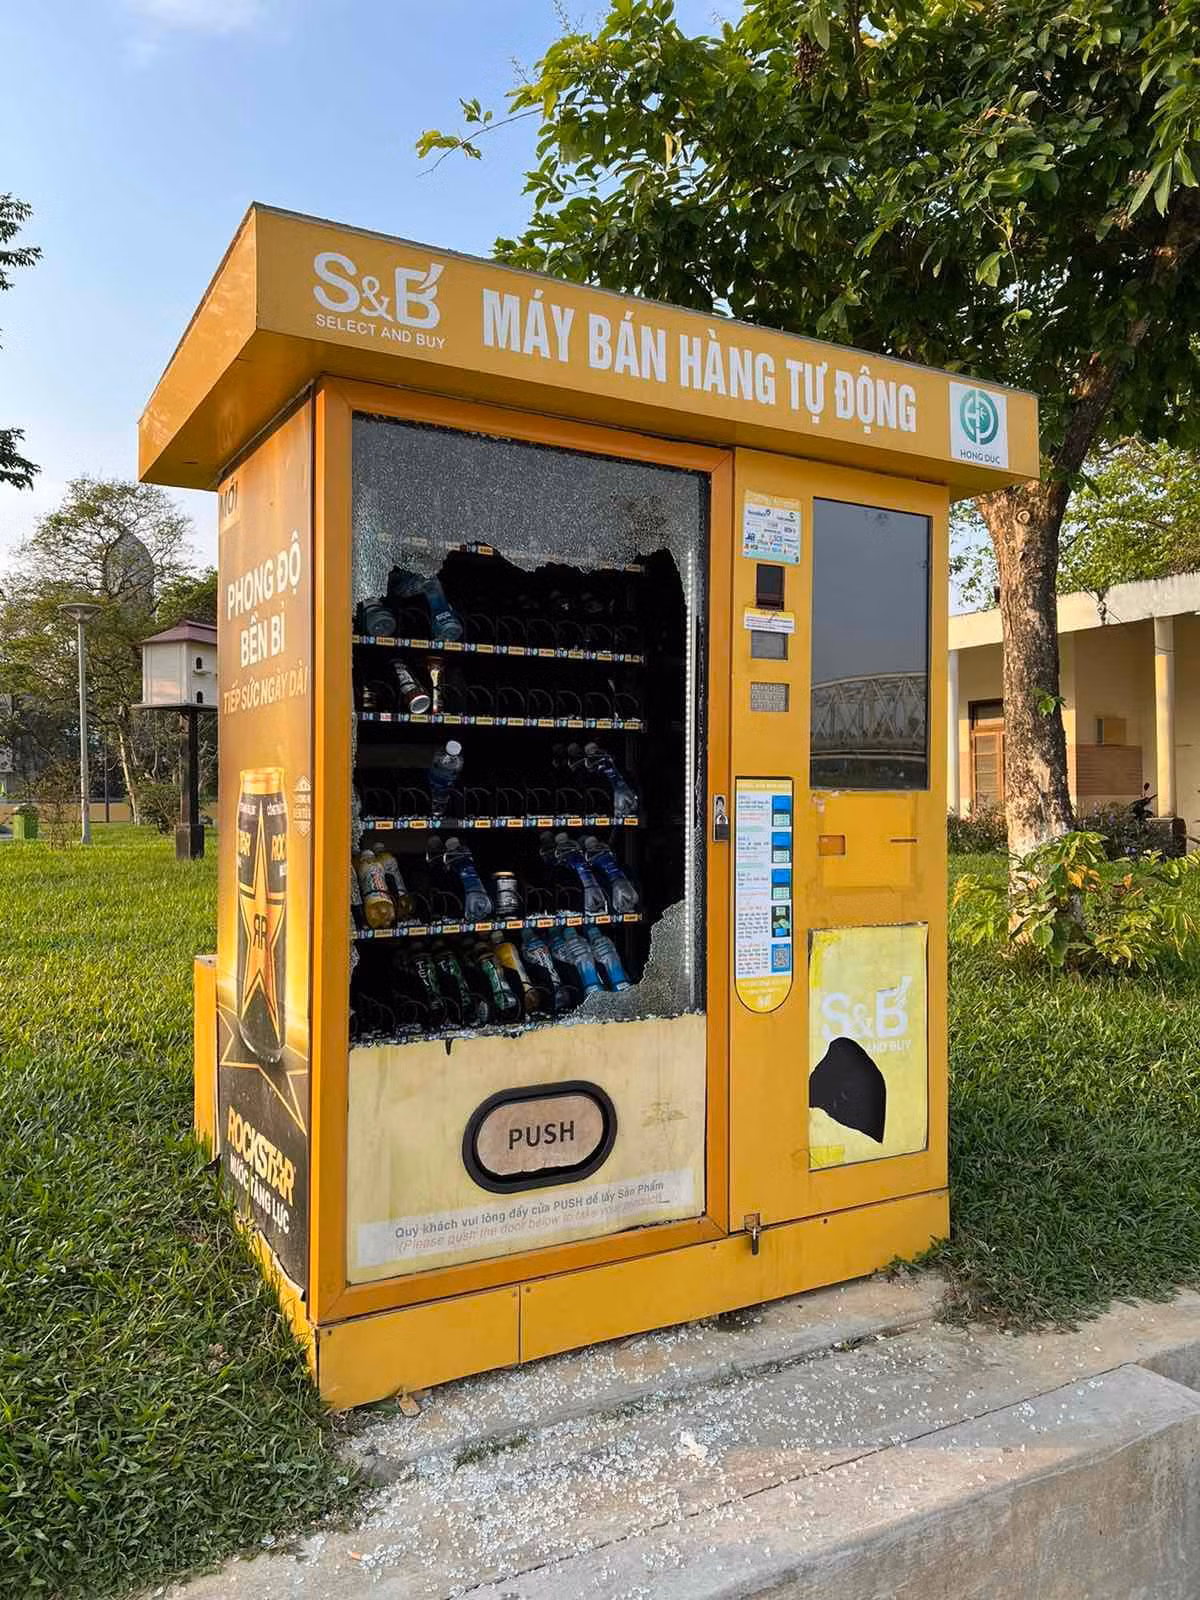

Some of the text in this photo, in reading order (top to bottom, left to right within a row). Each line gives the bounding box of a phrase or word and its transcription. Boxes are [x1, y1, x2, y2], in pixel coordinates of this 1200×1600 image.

[315, 313, 446, 349] SELECT AND BUY
[482, 288, 917, 434] MÁY BÁN HÀNG TỰ ĐỘNG
[227, 529, 301, 621] PHONG ĐỘ
[241, 610, 268, 668] BỀN
[227, 1104, 296, 1208] ROCKSTAR
[509, 1120, 575, 1151] PUSH
[422, 1217, 458, 1235] khách
[461, 1218, 479, 1228] vui
[481, 1211, 506, 1224] lòng
[553, 1198, 584, 1212] PUSH
